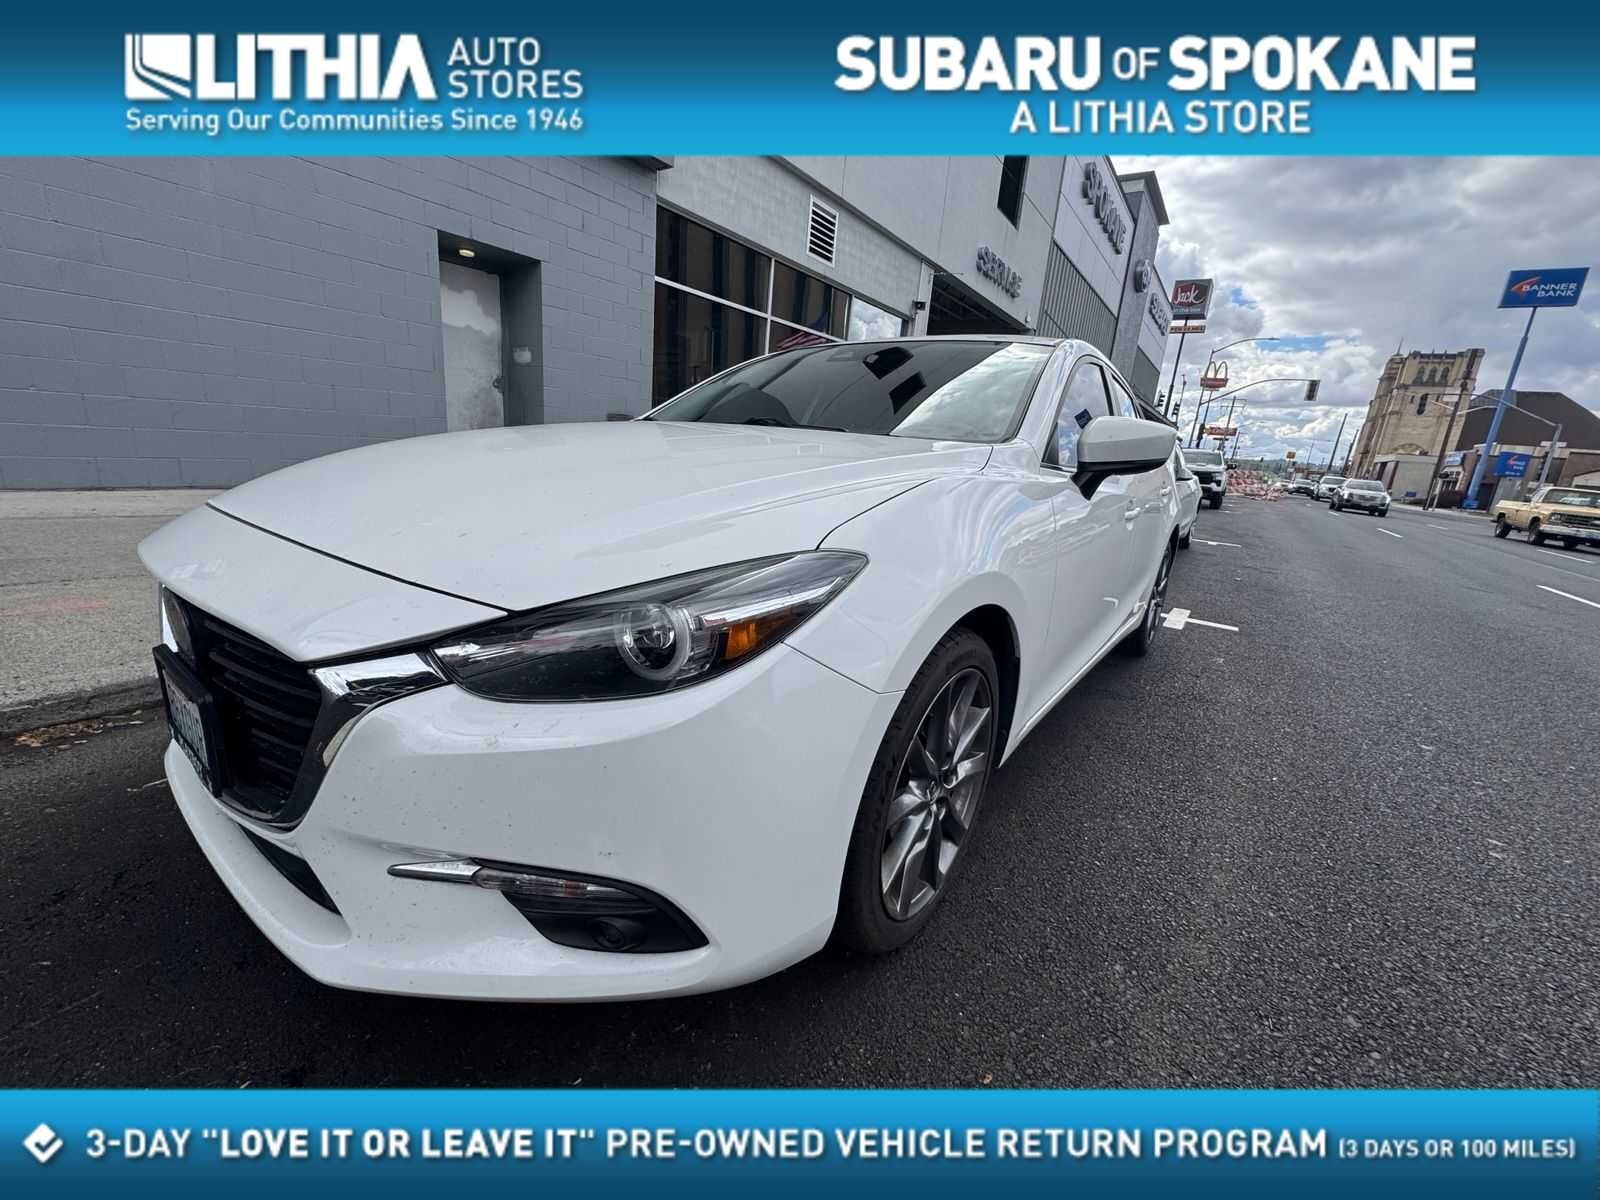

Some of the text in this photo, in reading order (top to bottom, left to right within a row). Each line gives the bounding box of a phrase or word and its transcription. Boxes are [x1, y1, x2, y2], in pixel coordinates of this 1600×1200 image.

[1522, 282, 1577, 292] BANNER
[1173, 284, 1207, 304] Jack
[1536, 289, 1575, 297] BANK
